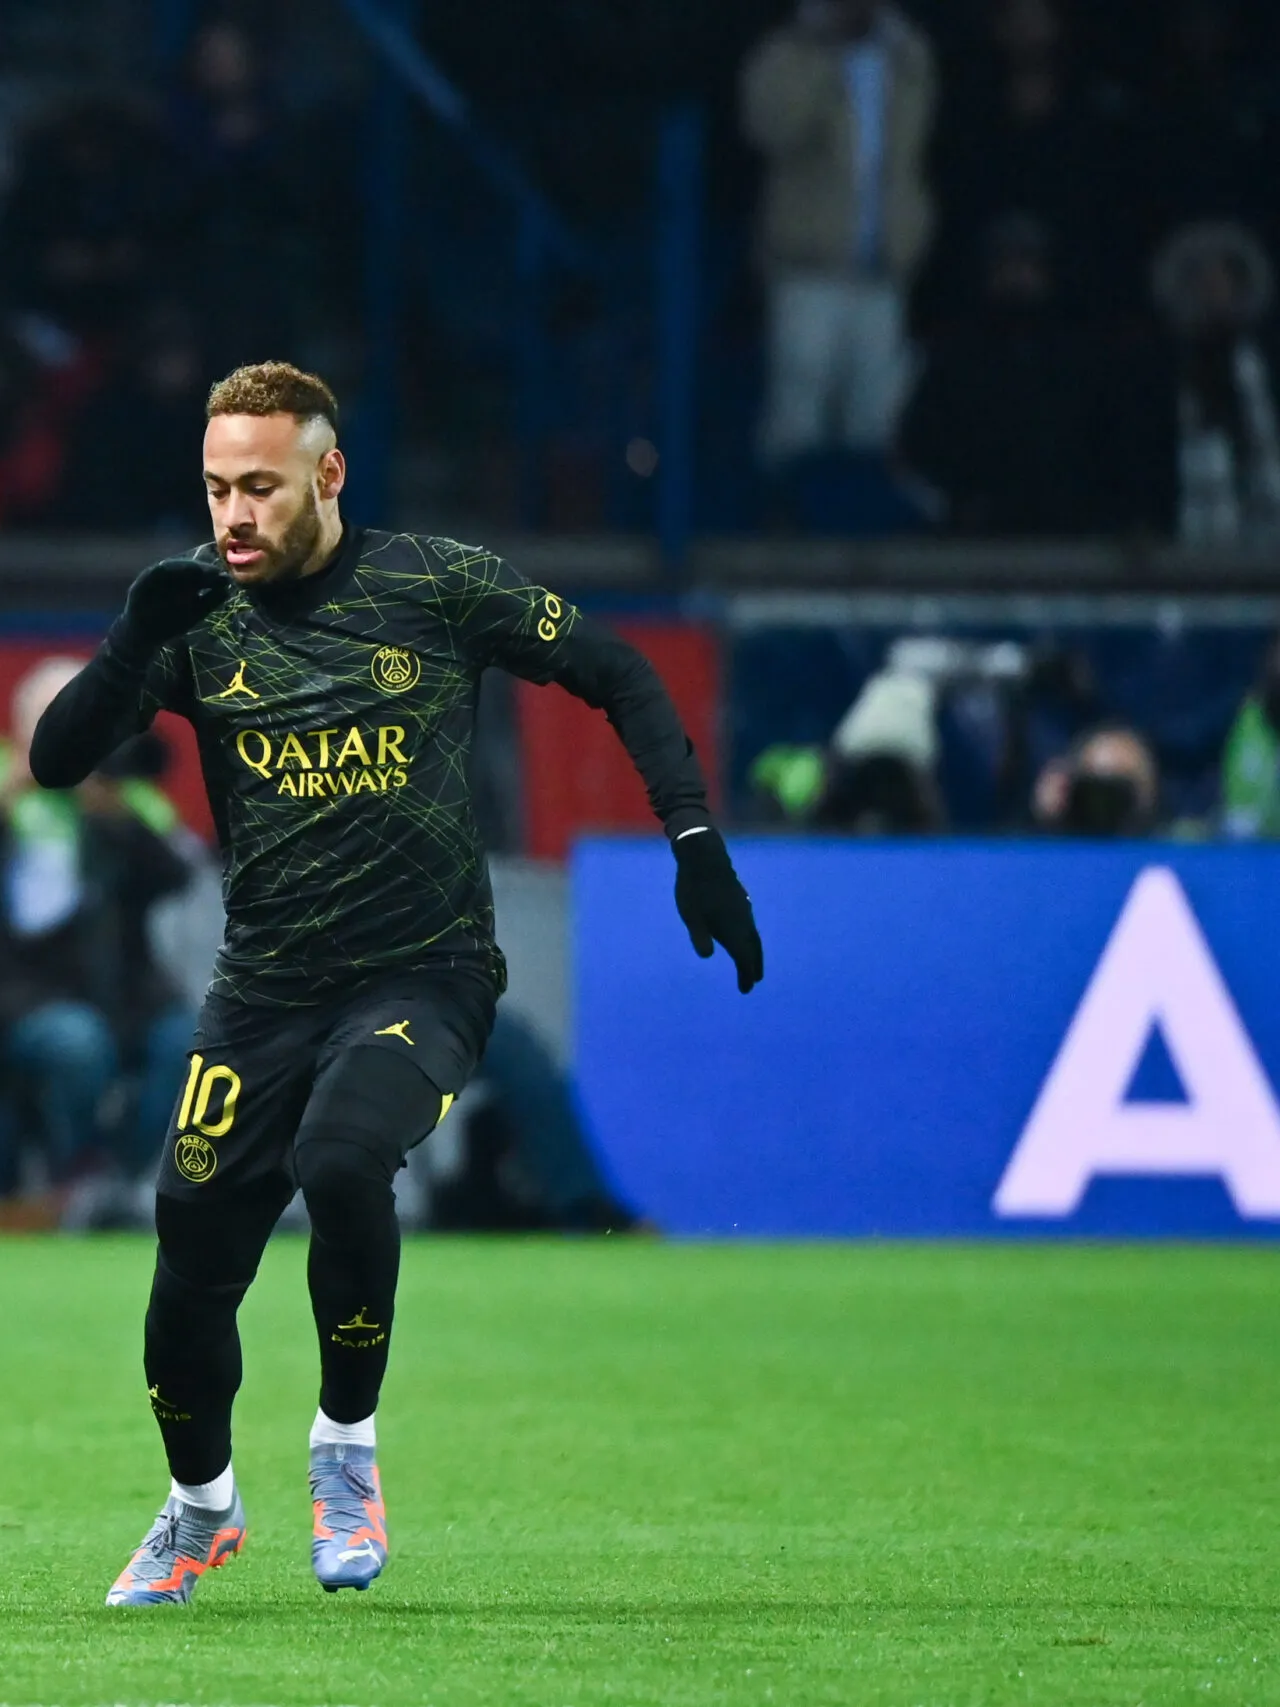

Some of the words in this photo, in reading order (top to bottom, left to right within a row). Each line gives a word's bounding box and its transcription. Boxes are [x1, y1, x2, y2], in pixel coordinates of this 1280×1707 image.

[378, 646, 409, 660] PARIS
[235, 725, 410, 779] QATAR
[277, 764, 408, 799] AIRWAYS
[177, 1054, 242, 1137] 10
[181, 1137, 210, 1152] PARIS
